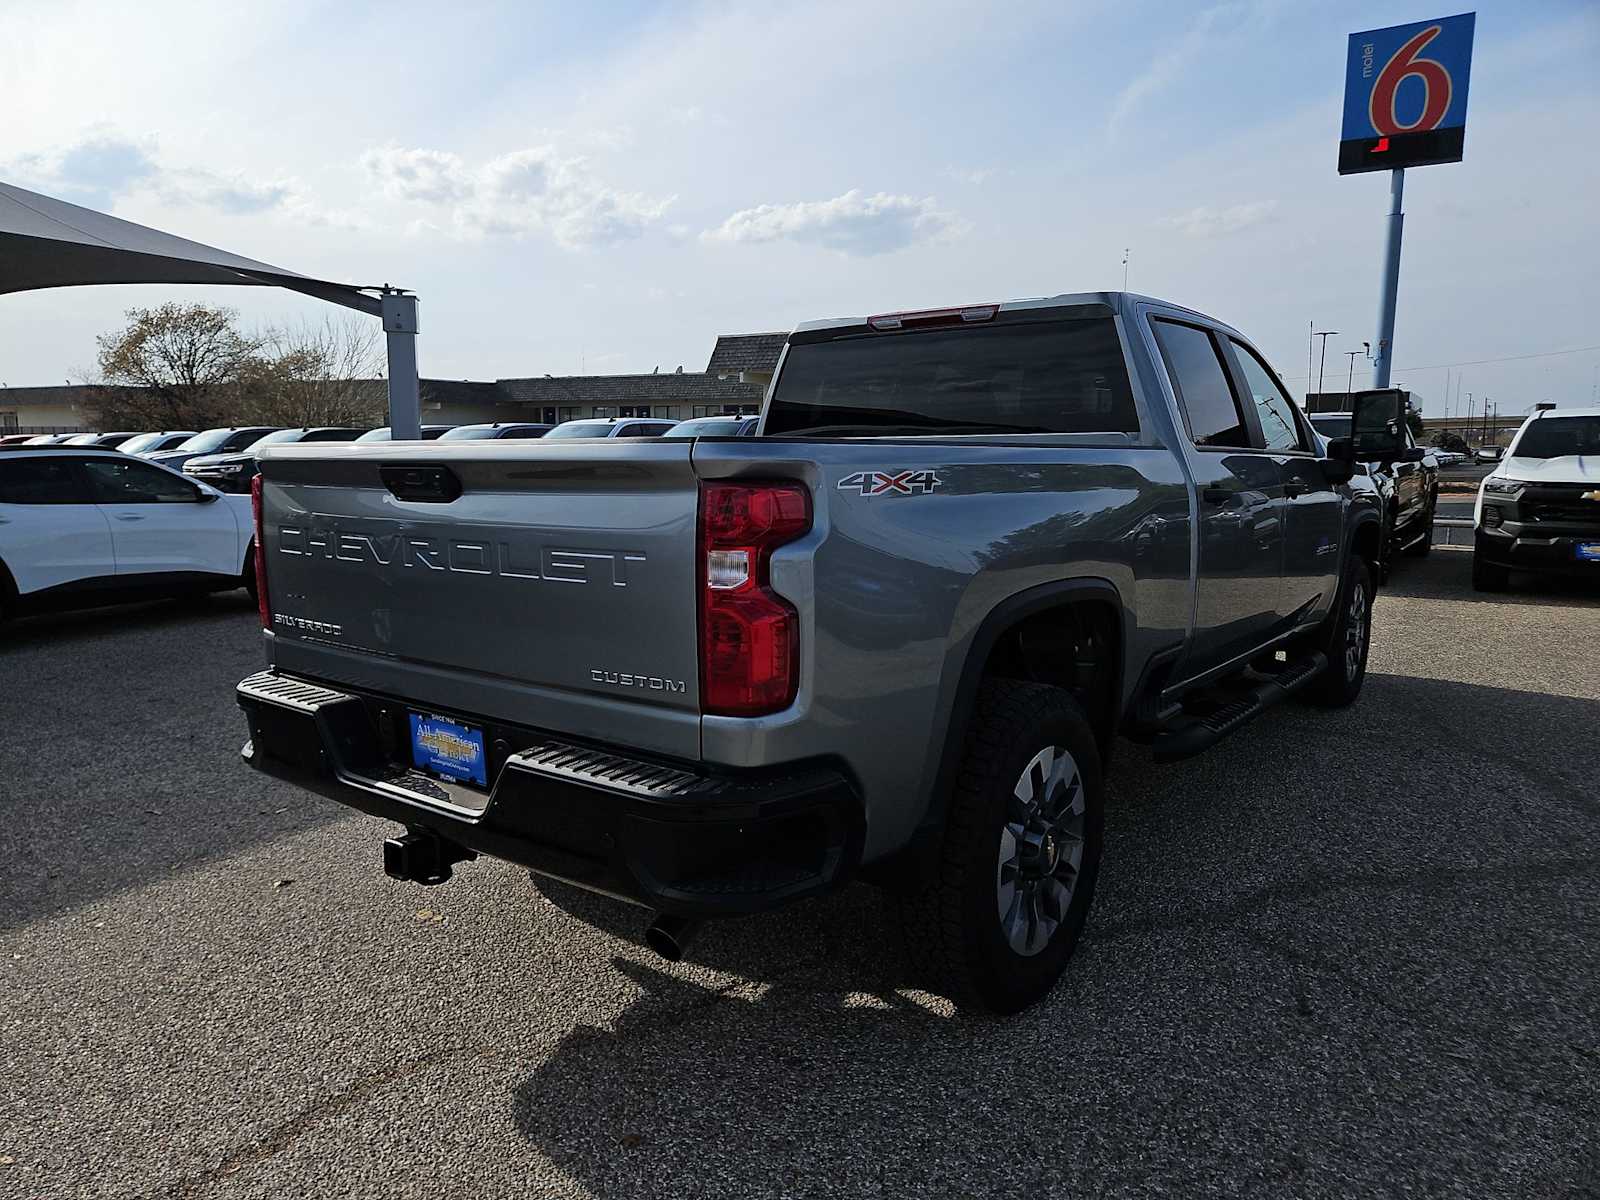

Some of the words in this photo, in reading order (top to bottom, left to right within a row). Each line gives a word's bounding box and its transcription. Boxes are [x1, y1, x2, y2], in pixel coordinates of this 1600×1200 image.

[1369, 25, 1453, 137] 6
[278, 526, 647, 588] CHEVROLET
[274, 613, 342, 636] SILVERADO
[591, 669, 686, 693] CUSTOM
